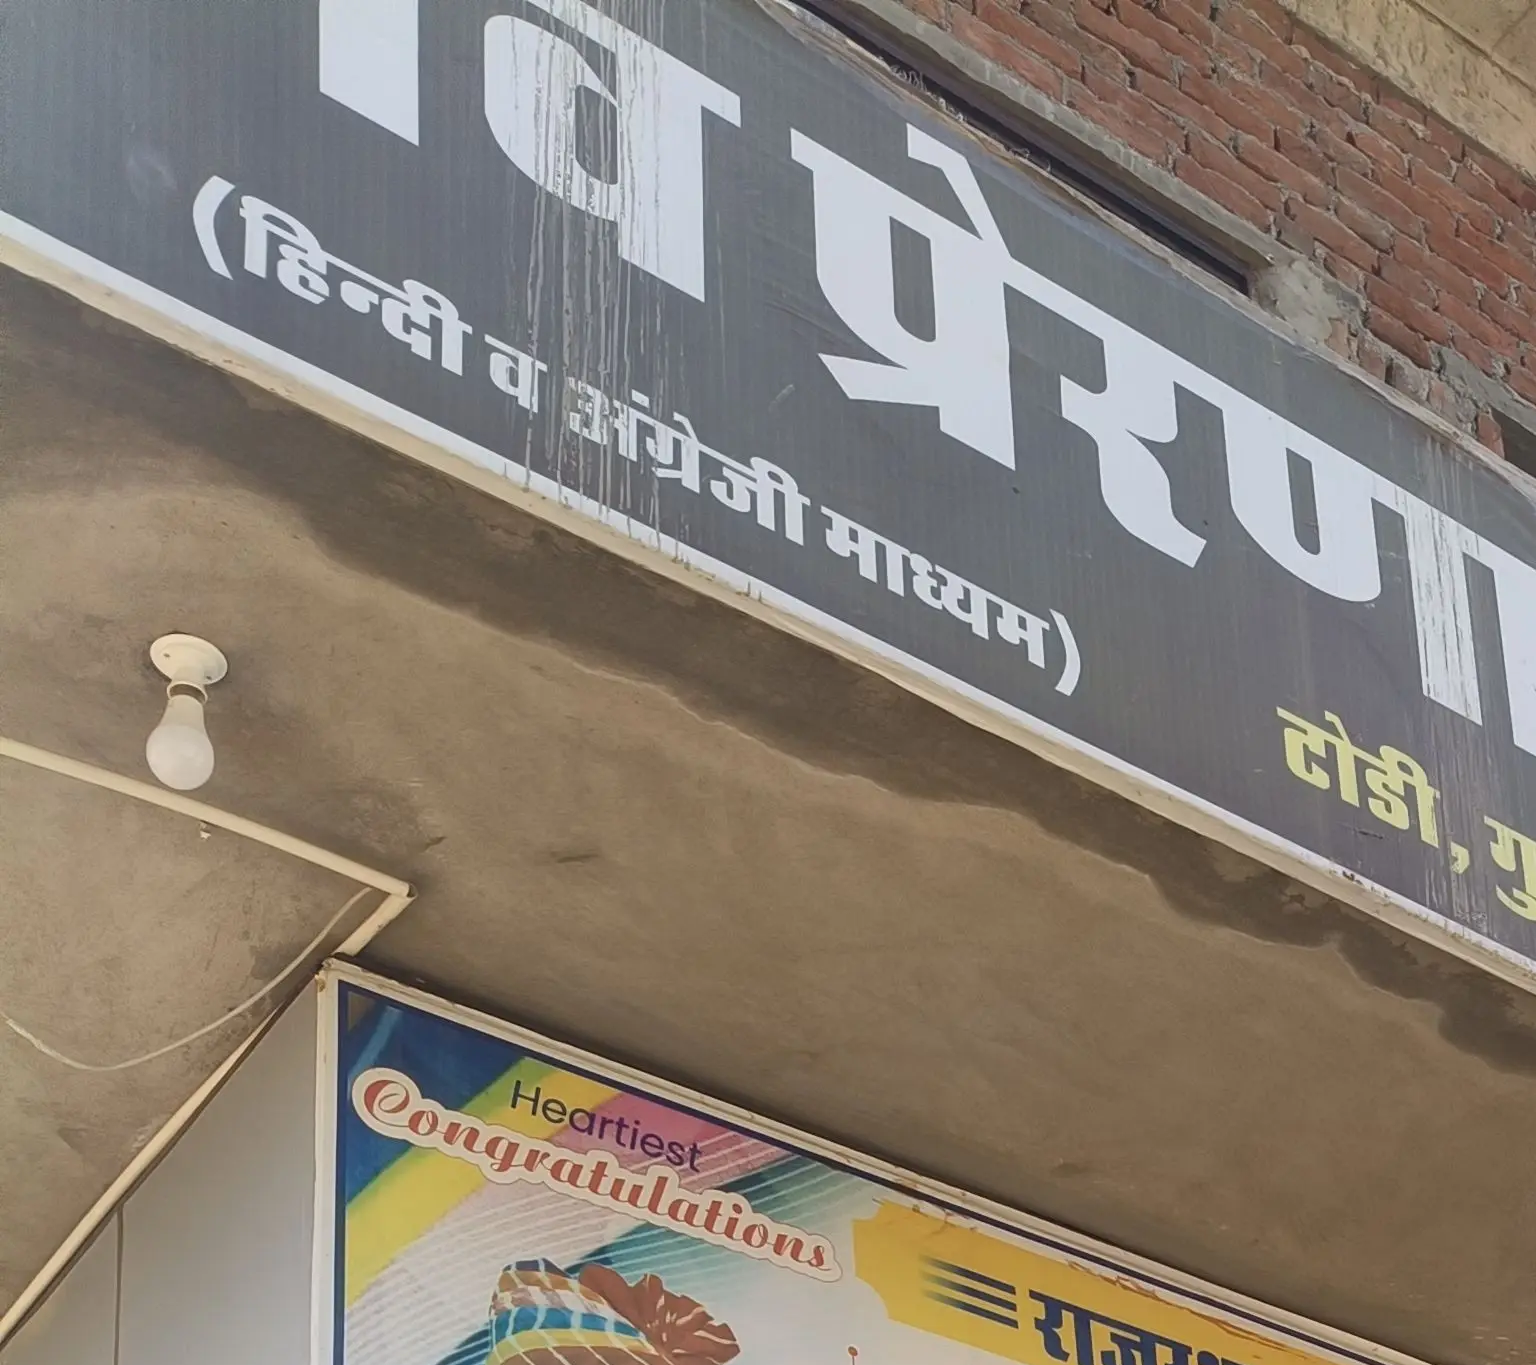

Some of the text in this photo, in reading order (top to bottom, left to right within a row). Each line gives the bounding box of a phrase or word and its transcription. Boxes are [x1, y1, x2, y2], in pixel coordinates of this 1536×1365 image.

[193, 175, 1081, 696] (हिन्दी व अंग्रेजी माध्यम)
[363, 1079, 832, 1273] Congratulations
[509, 1081, 702, 1173] Heartiest
